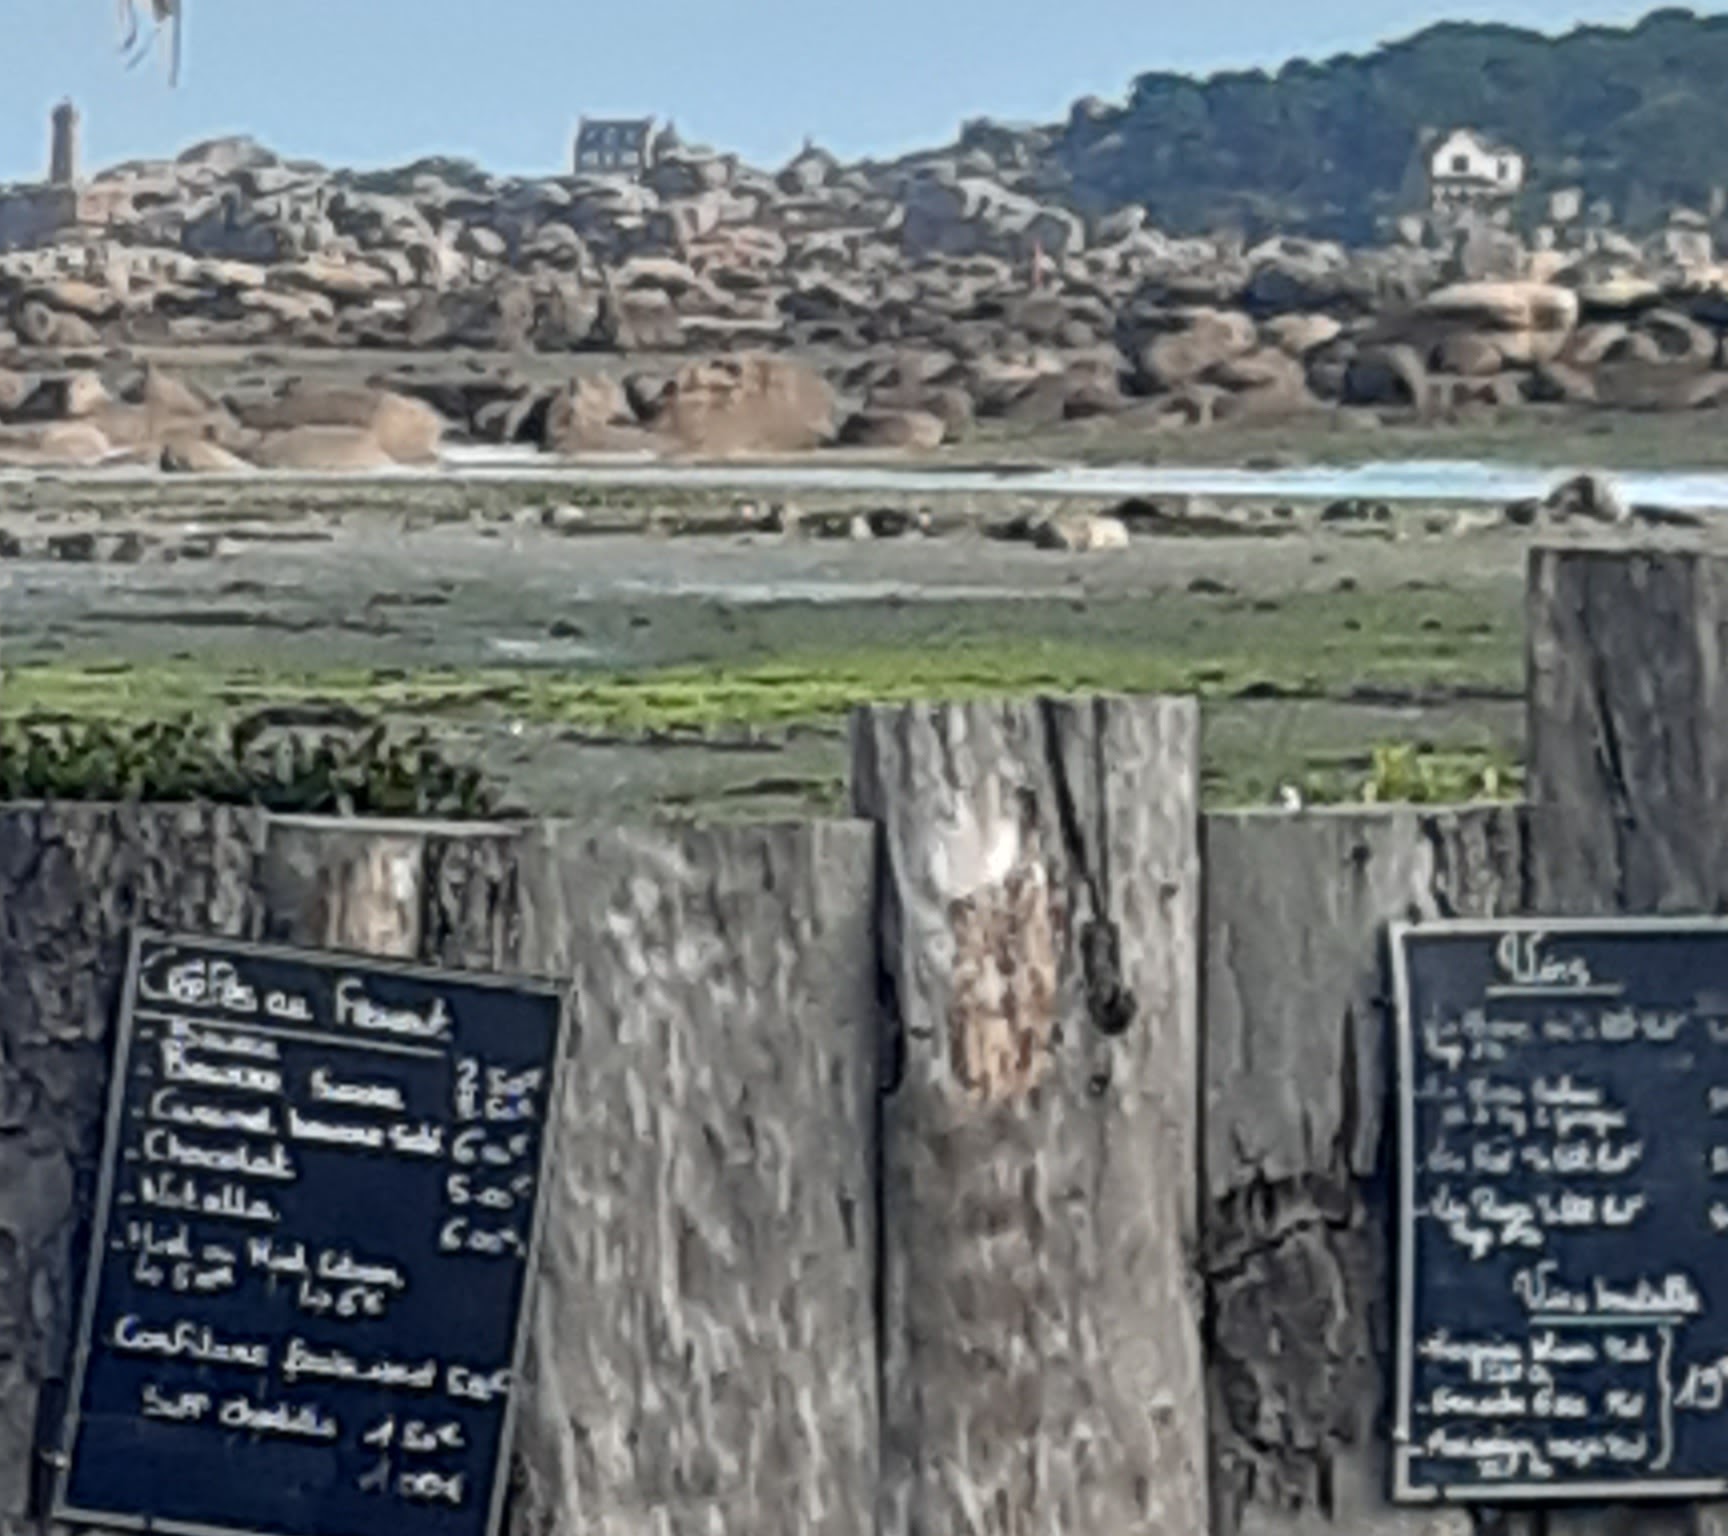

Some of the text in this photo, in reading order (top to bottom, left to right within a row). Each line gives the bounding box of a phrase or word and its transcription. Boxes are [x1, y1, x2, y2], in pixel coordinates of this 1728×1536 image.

[265, 990, 314, 1021] au
[143, 1128, 297, 1180] Chocolat
[140, 1171, 280, 1222] Nutella
